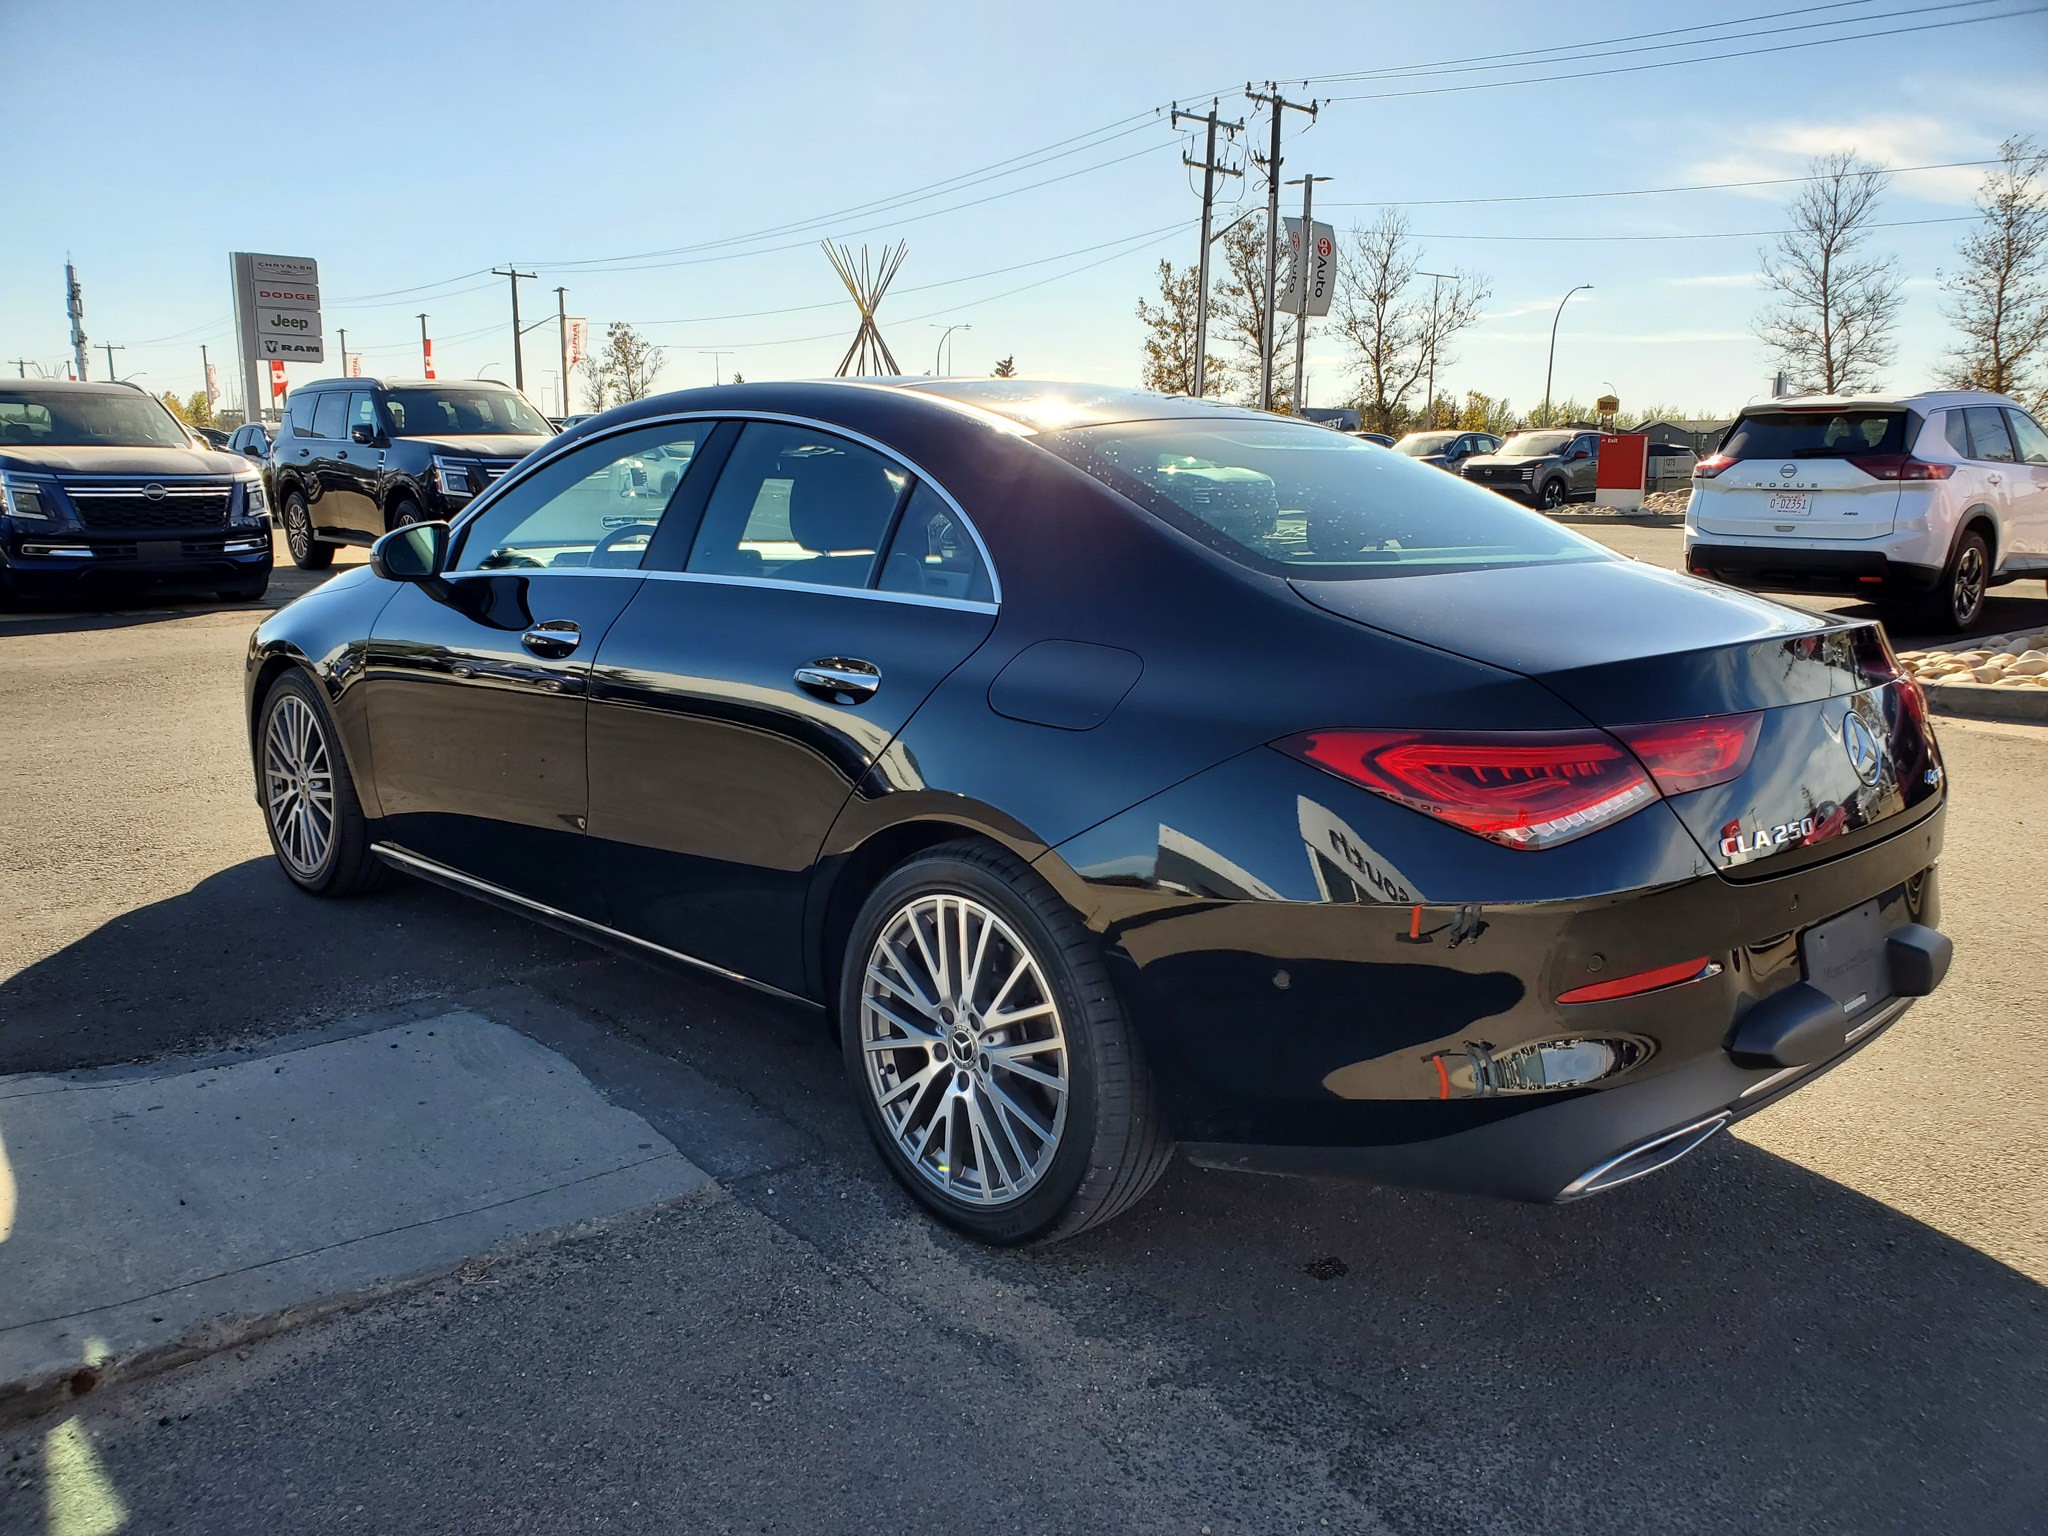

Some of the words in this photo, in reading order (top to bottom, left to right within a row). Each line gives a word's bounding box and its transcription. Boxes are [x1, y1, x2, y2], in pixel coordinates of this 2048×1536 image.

[257, 262, 313, 271] CHRYSLER
[260, 290, 316, 301] DODGE
[271, 314, 308, 330] Jeep
[281, 344, 320, 353] RAM
[1665, 458, 1676, 467] 1275
[1719, 830, 1772, 857] CLA
[1772, 818, 1814, 844] 250
